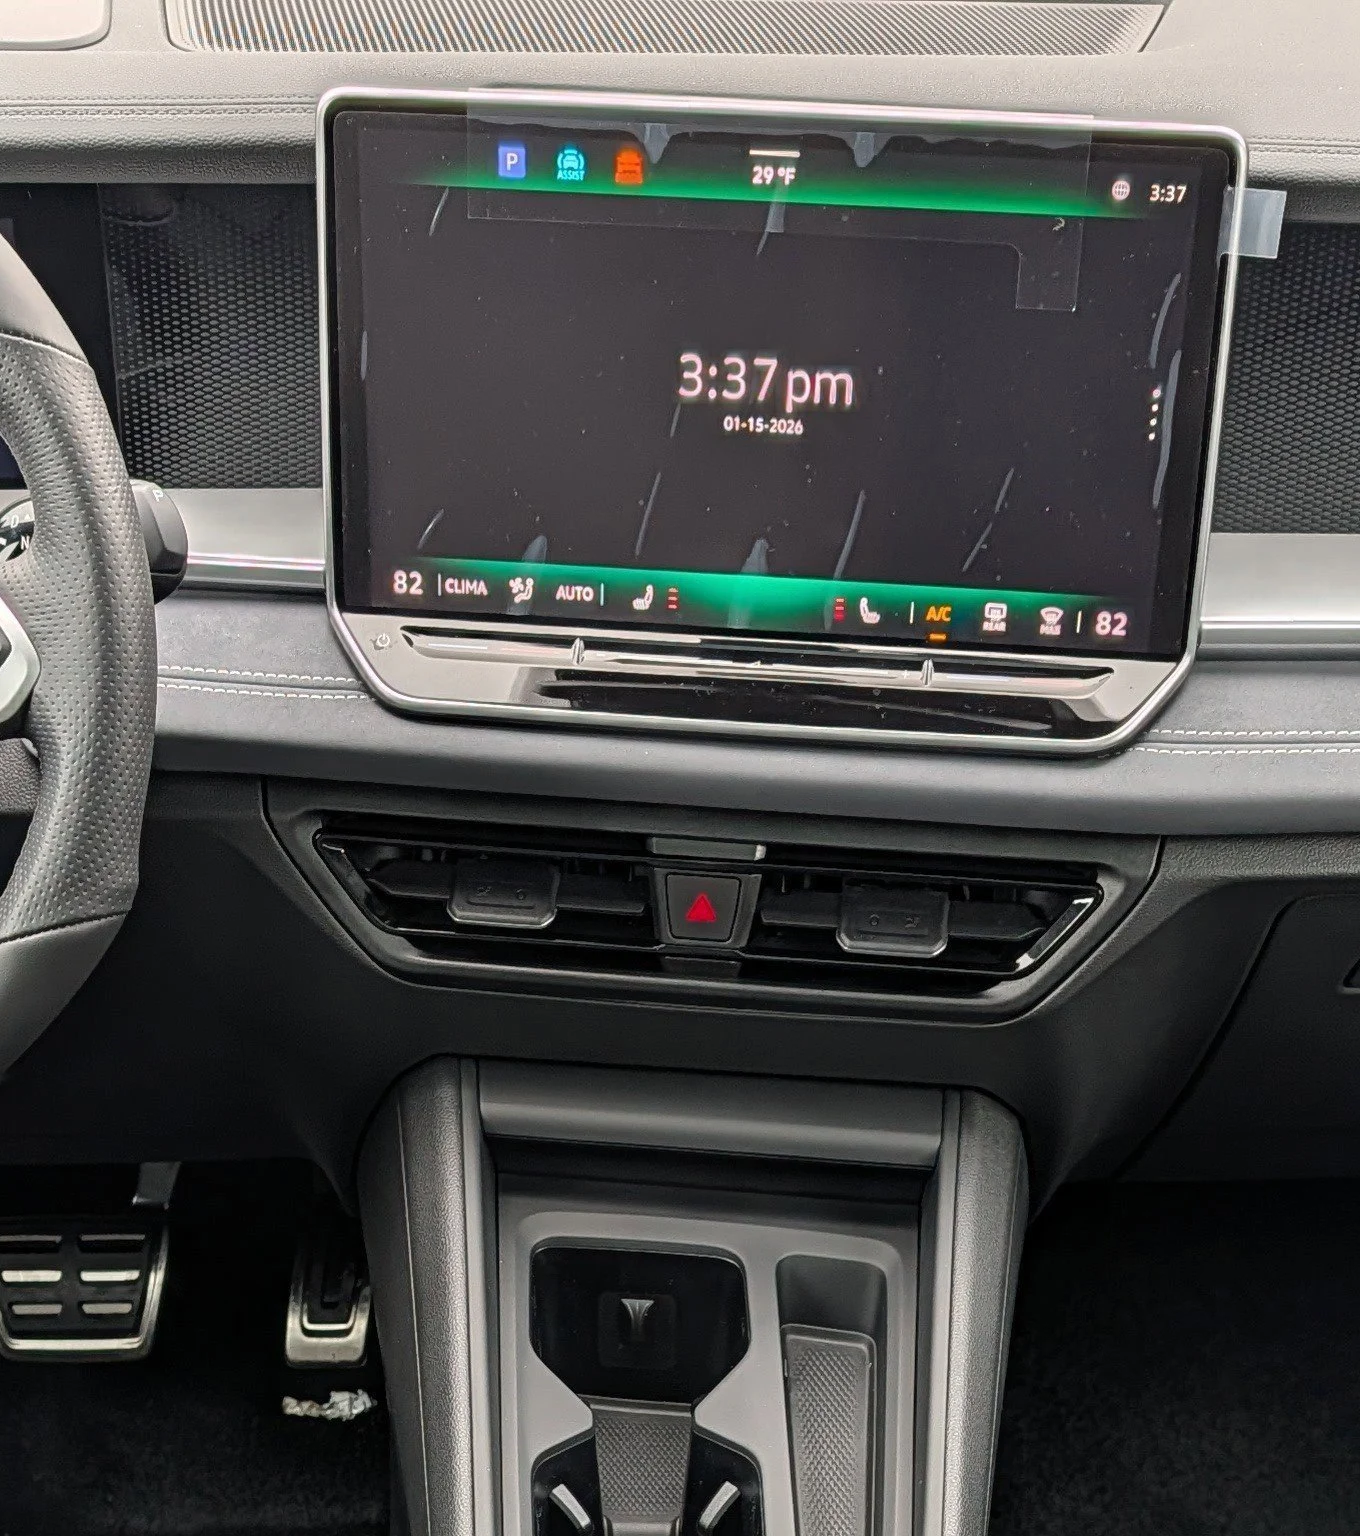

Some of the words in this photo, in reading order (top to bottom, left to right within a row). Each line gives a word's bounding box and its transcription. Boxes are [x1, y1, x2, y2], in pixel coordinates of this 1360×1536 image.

[506, 152, 518, 171] P
[557, 170, 585, 180] ASSIST
[752, 165, 774, 185] 29
[1149, 183, 1187, 203] 3:37
[679, 353, 778, 402] 3:37
[785, 369, 853, 413] pm
[723, 415, 804, 435] 01-15-2026
[20, 534, 30, 551] N
[393, 570, 423, 595] 82
[445, 577, 488, 596] CLIMA
[555, 585, 594, 601] AUTO
[926, 606, 952, 622] A/C
[1095, 610, 1128, 637] 82
